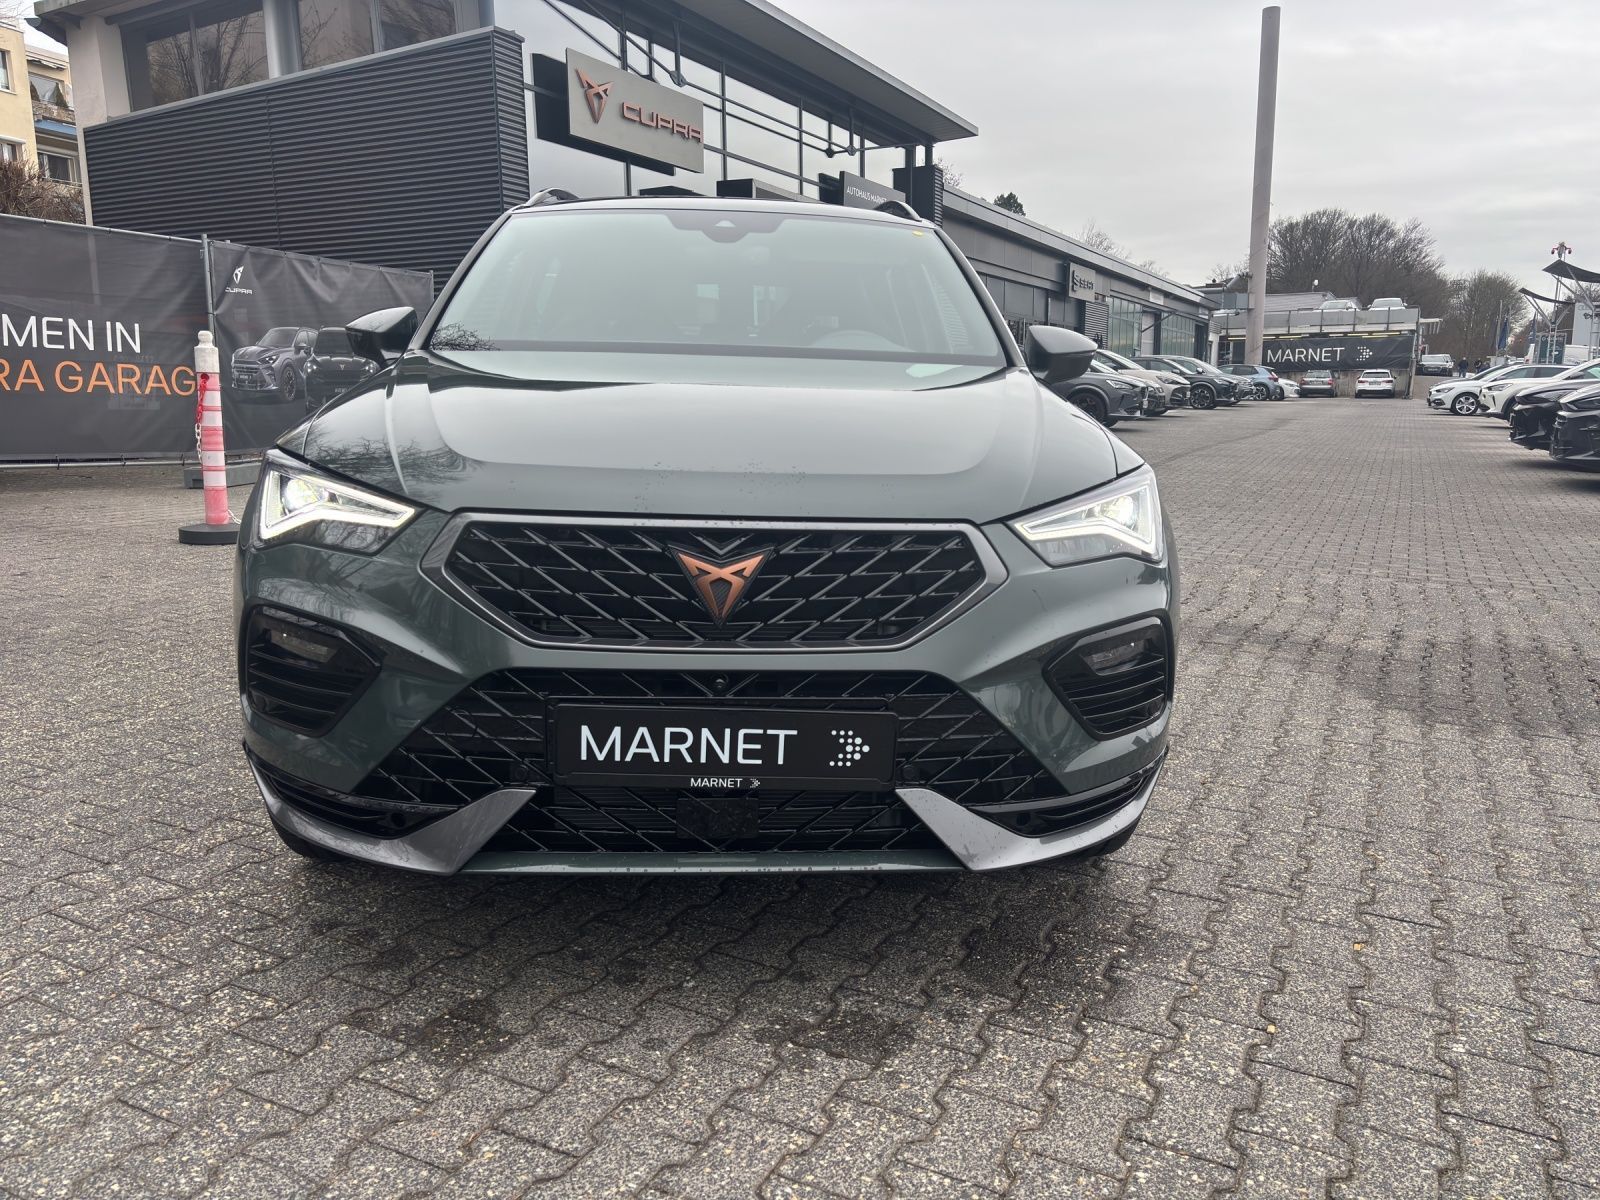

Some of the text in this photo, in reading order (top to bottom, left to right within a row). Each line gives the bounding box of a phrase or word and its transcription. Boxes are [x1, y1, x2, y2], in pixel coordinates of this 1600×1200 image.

[622, 101, 704, 144] CUPRA
[846, 185, 871, 201] AUTOHAUS
[224, 286, 253, 295] CUPRA
[1, 313, 141, 354] MEN IN
[1266, 347, 1346, 363] MARNET
[580, 725, 798, 765] MARNET
[690, 777, 743, 788] MARNET
